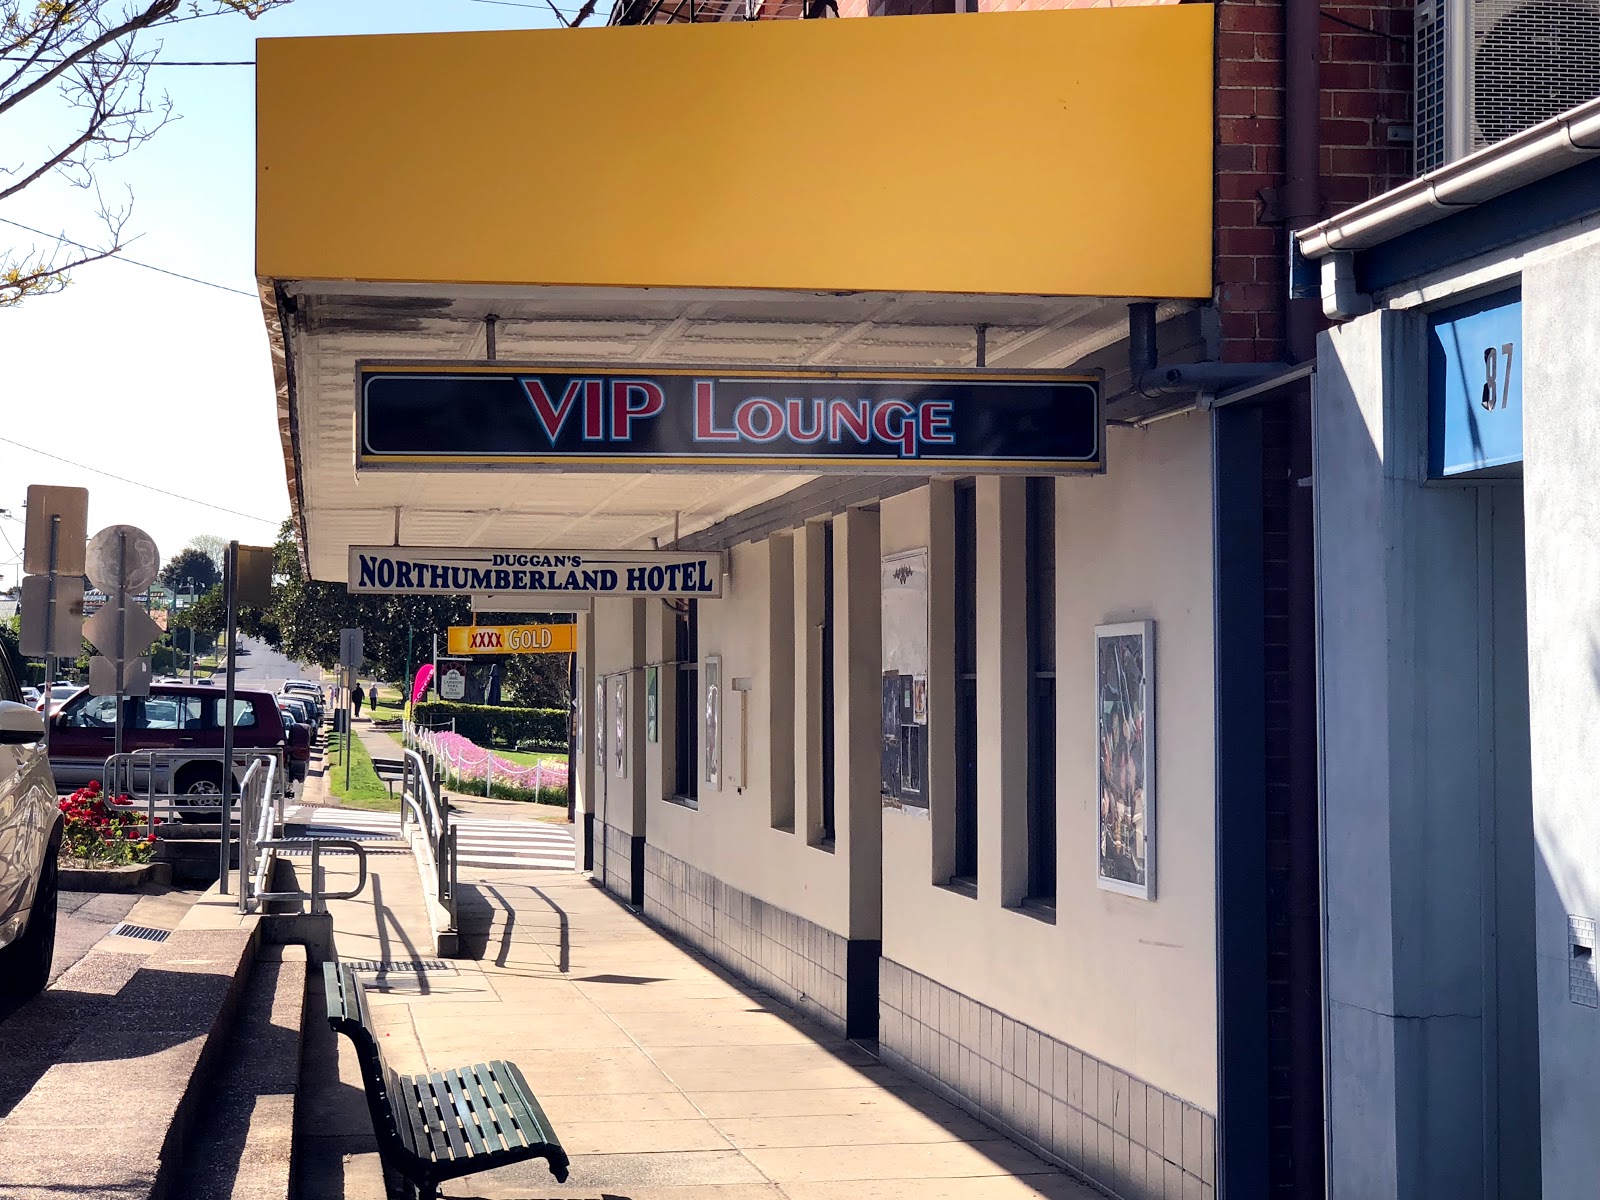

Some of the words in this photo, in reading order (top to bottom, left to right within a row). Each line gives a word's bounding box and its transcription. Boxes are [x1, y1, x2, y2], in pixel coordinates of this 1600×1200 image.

[1481, 343, 1514, 412] 87
[519, 377, 666, 448] VIP
[692, 377, 956, 458] LOUNGE
[358, 554, 618, 591] NORTHUMBERLAND
[626, 560, 713, 592] HOTEL
[491, 554, 583, 568] DUGGAN'S
[470, 631, 503, 649] XXXX
[508, 627, 552, 650] GOLD
